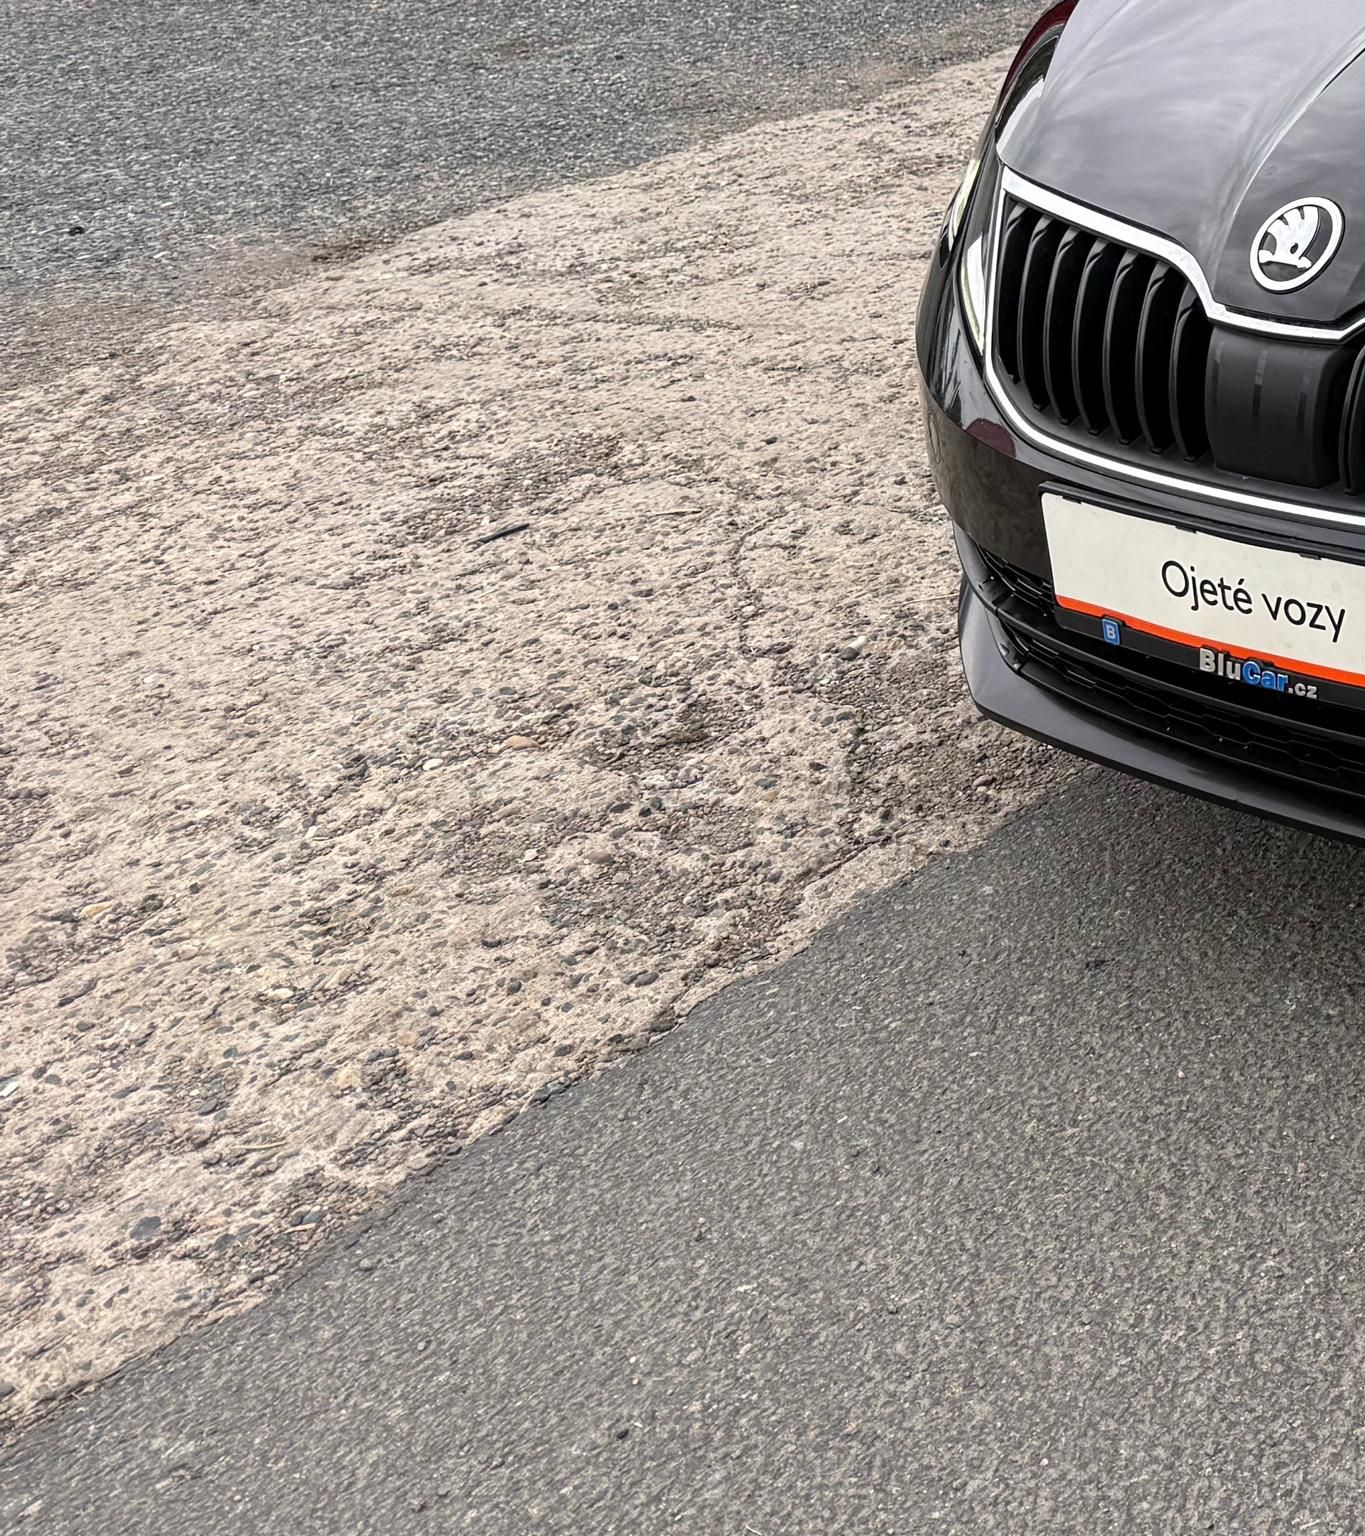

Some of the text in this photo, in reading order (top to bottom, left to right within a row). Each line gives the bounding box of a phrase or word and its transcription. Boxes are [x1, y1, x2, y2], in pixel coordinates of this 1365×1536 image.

[1161, 560, 1346, 643] Ojeté vozy
[1199, 647, 1318, 700] BluCar.cz
